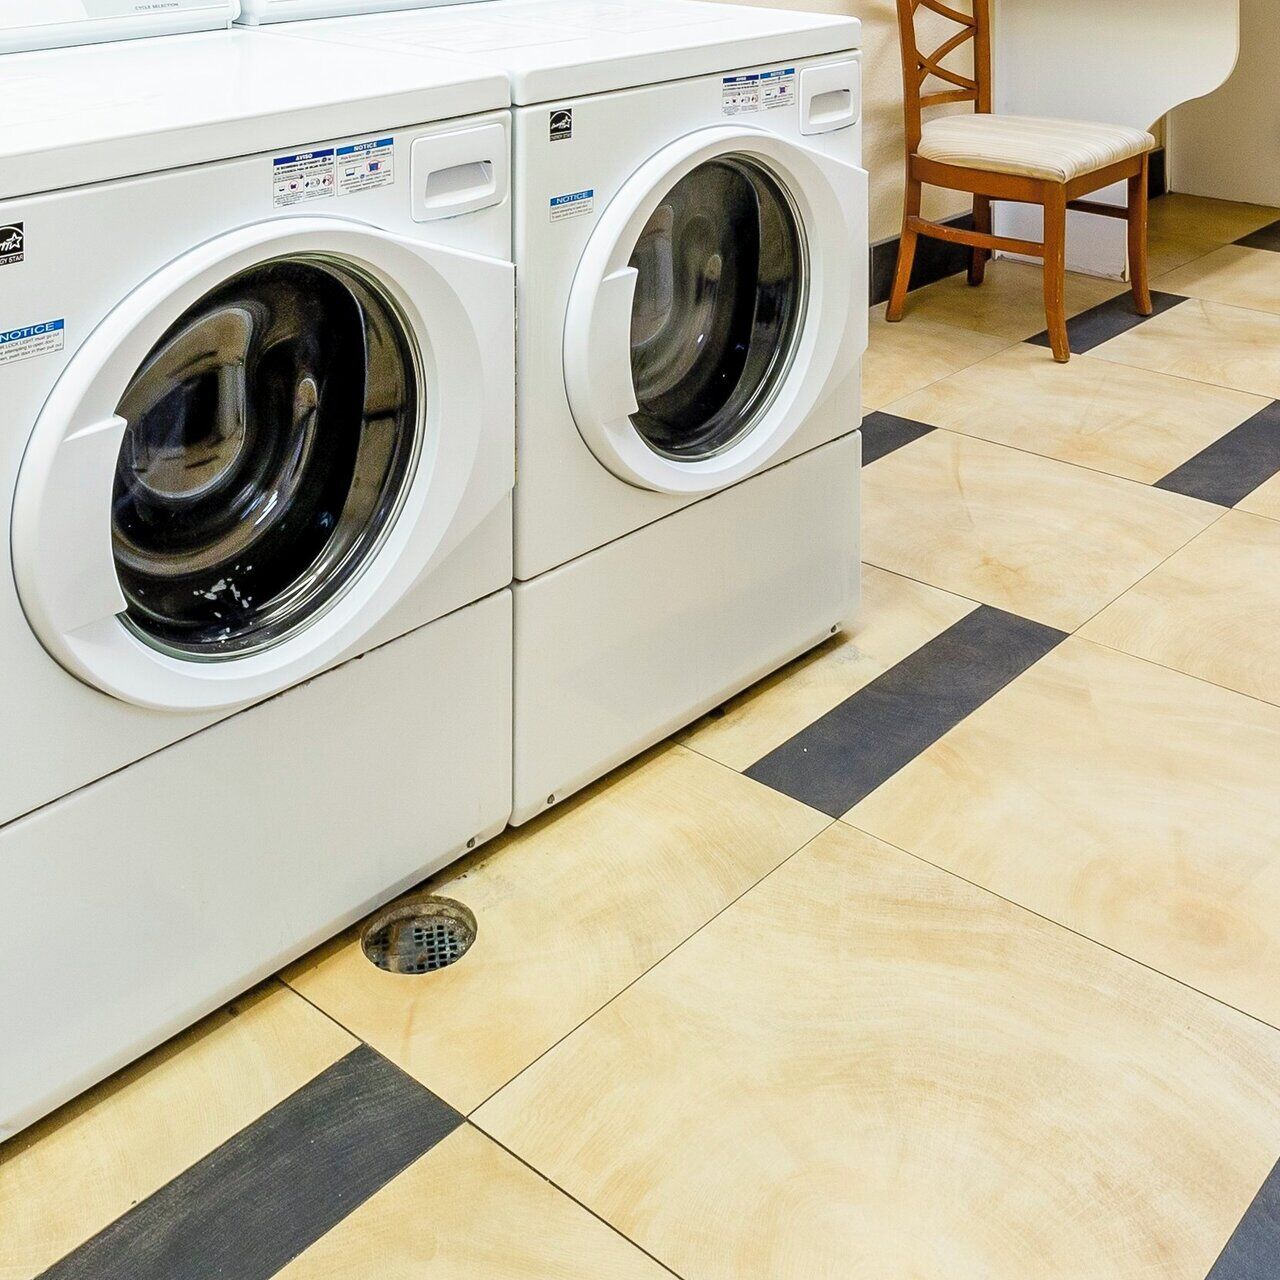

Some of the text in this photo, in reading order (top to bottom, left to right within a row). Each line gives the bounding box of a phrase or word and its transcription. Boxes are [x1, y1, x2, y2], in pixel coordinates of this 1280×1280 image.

[353, 142, 377, 151] NOTICE
[296, 153, 313, 161] AVISO
[556, 191, 589, 204] NOTICE
[9, 253, 24, 263] STAR
